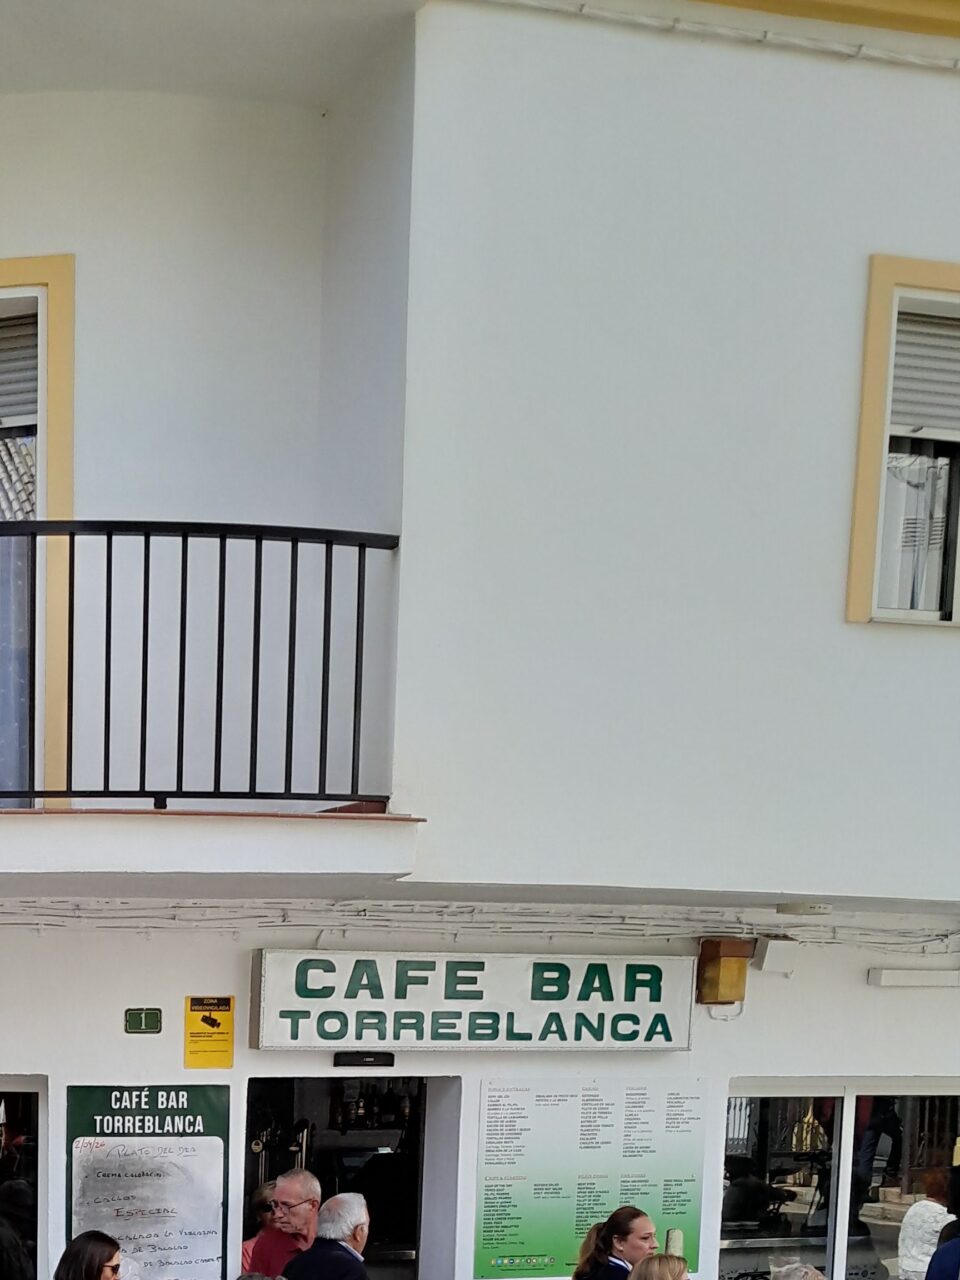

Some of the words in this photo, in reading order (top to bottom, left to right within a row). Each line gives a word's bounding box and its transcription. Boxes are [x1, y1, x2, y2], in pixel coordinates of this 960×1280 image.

[294, 958, 486, 1000] CAFE
[530, 961, 663, 1002] BAR
[140, 1012, 146, 1029] 1
[279, 1009, 673, 1043] TORREBLANCA
[111, 1087, 150, 1109] CAFÉ
[157, 1091, 188, 1109] BAR
[94, 1115, 204, 1134] TORREBLANCA
